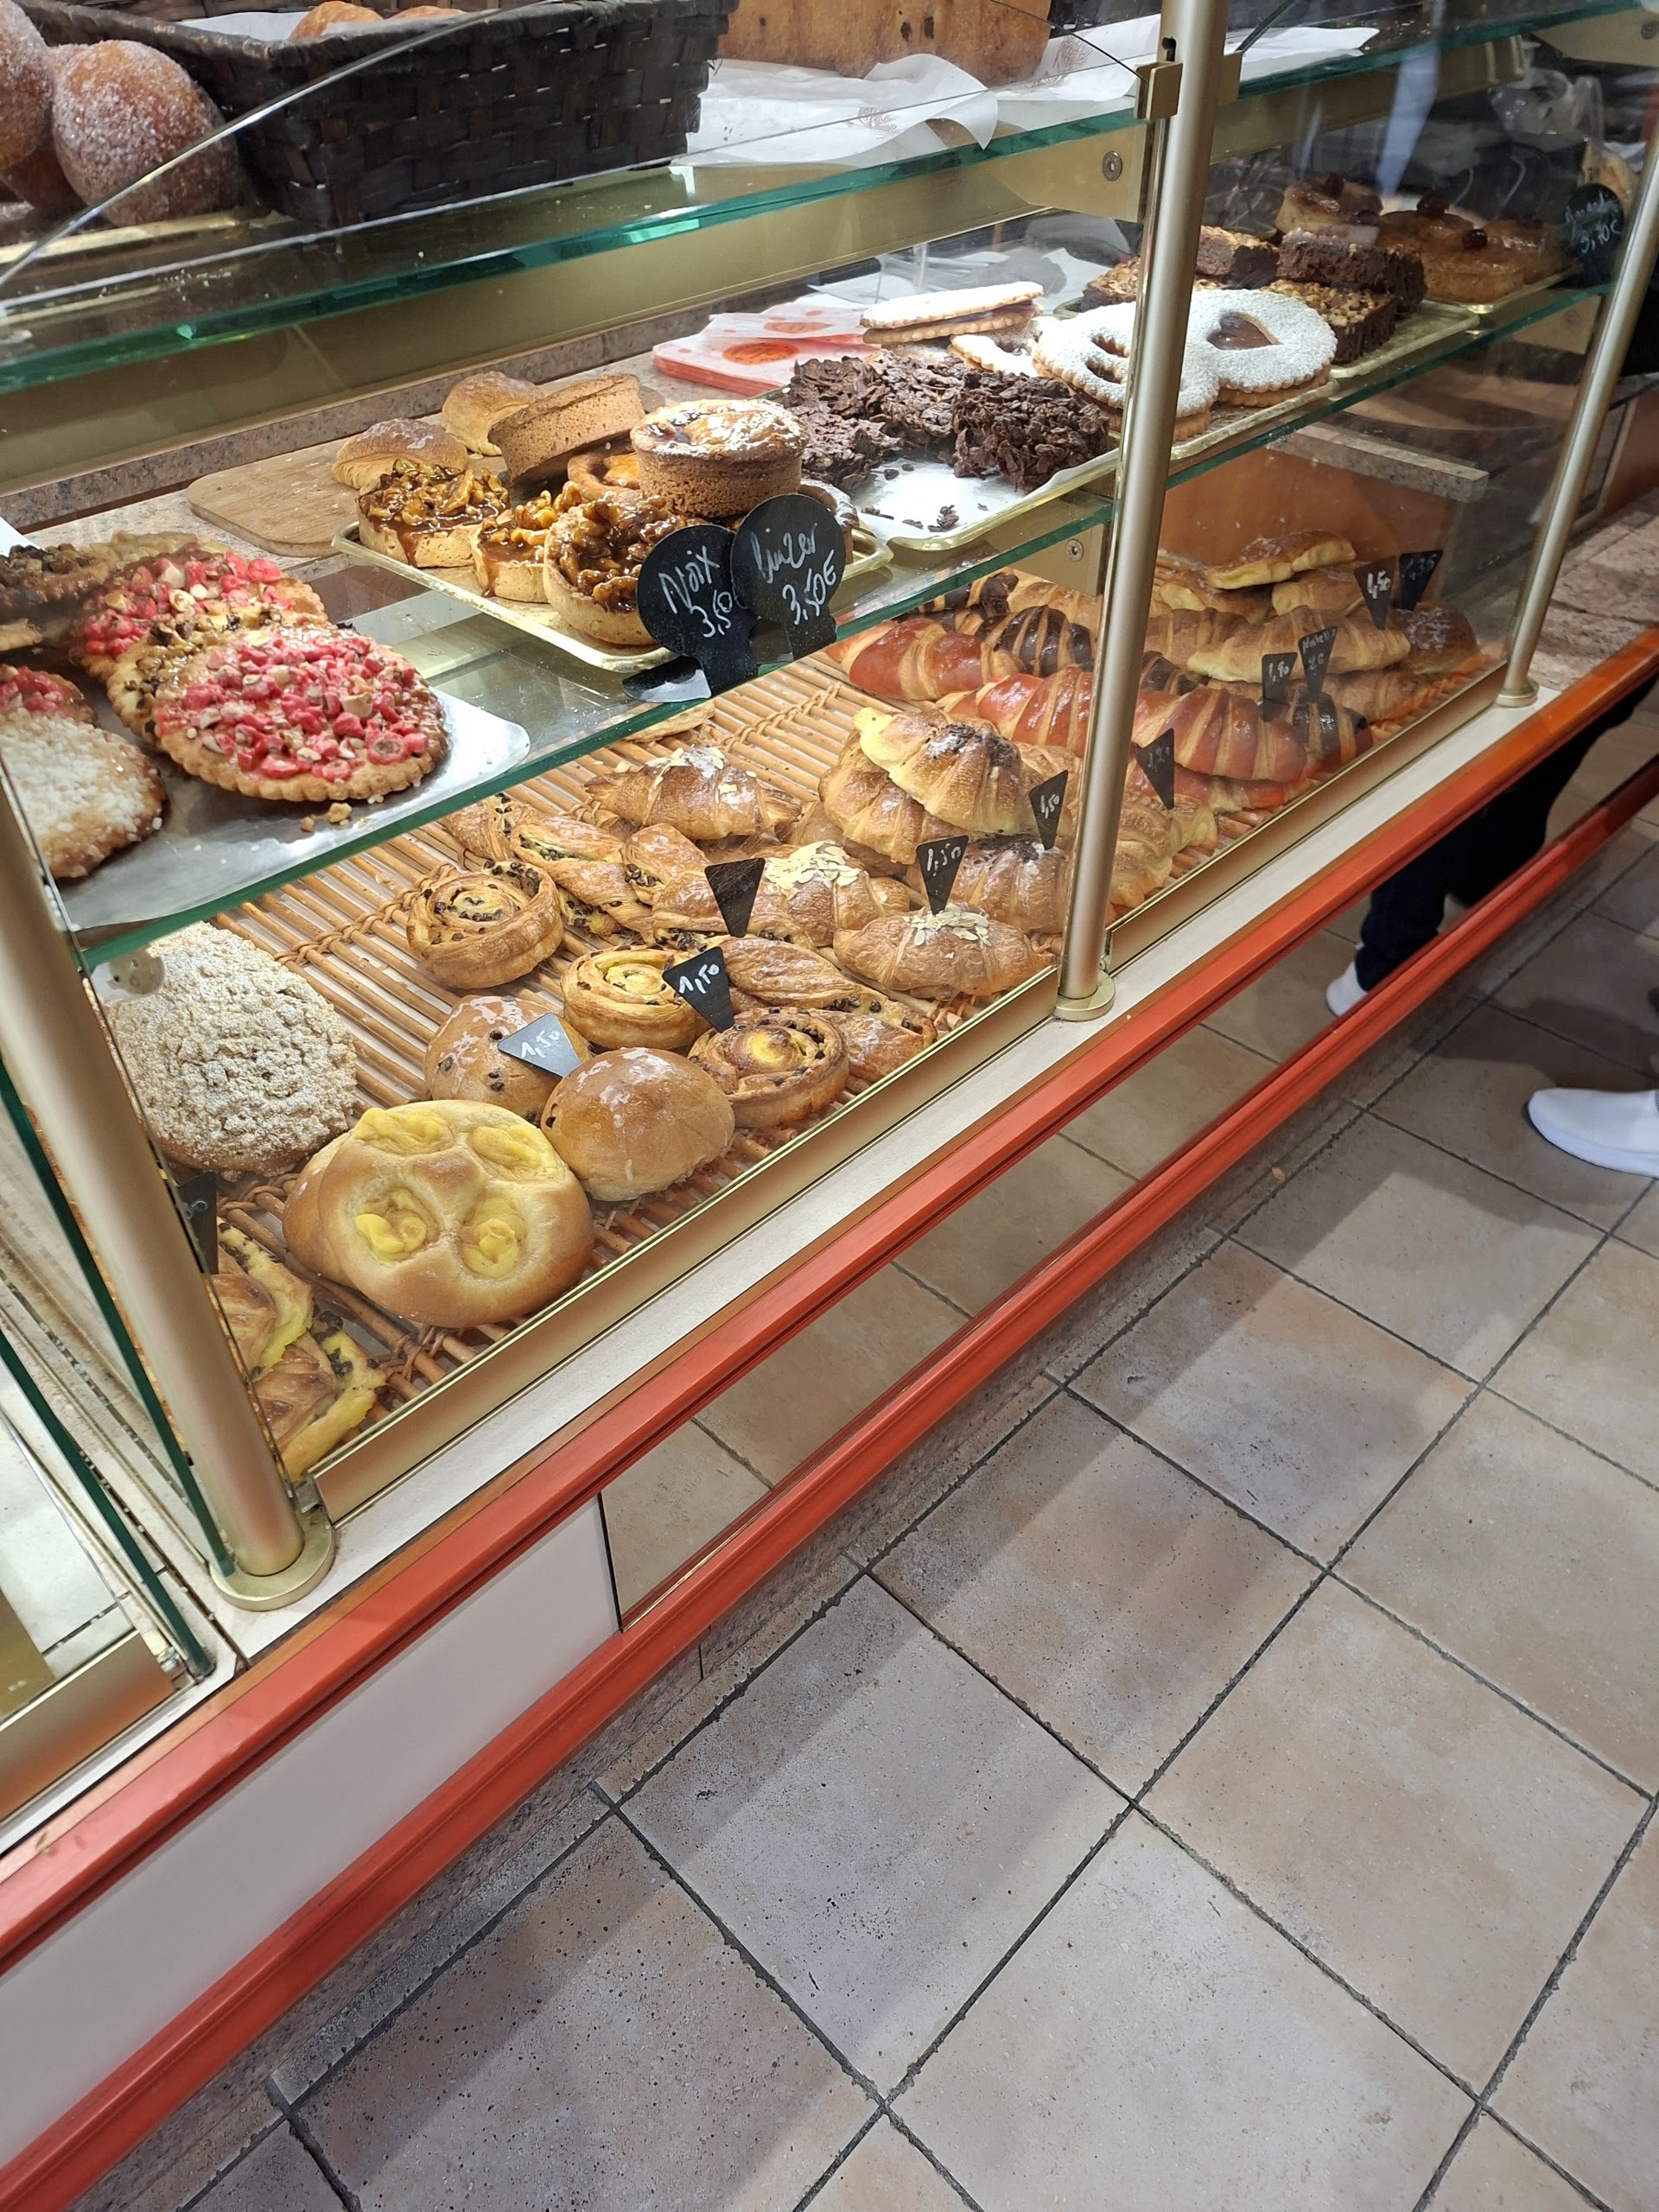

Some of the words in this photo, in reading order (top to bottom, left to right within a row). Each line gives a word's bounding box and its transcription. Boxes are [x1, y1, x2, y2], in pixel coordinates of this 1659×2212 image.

[690, 589, 734, 639] 3,50
[1039, 793, 1060, 819] 1,50
[926, 842, 961, 877] 1,50
[678, 963, 721, 995] 1,50
[520, 1028, 562, 1059] 1,50
